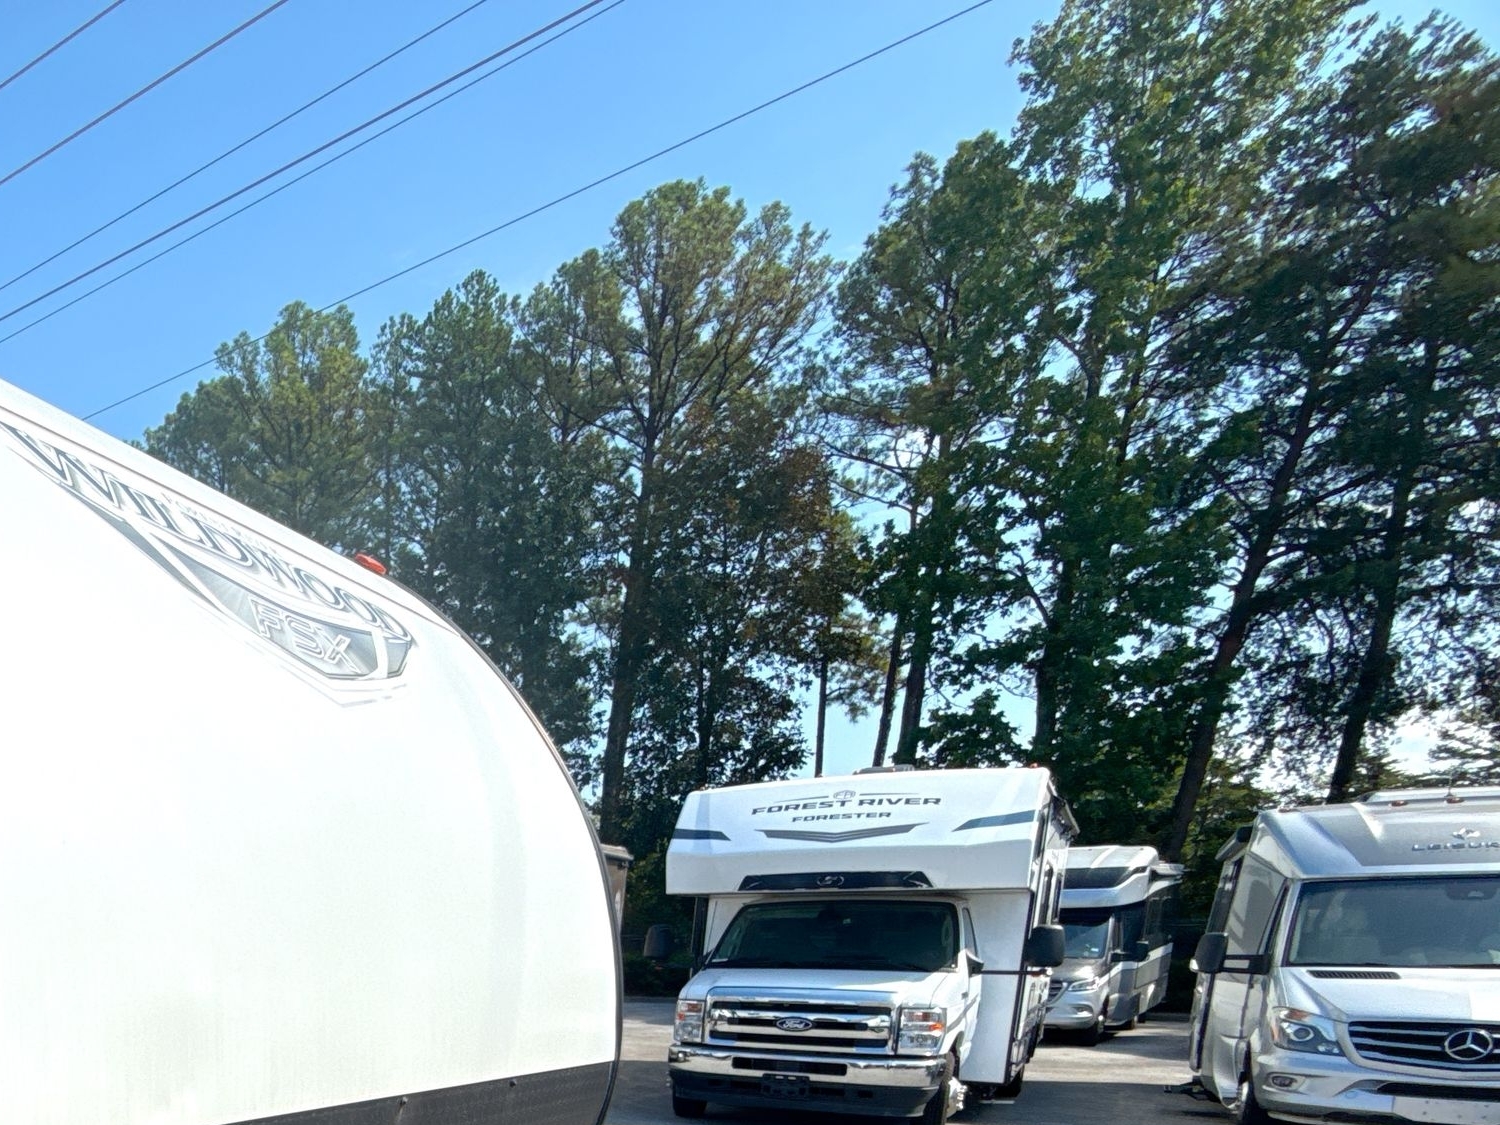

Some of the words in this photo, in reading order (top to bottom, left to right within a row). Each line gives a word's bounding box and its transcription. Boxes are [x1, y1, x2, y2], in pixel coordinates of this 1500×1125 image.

[248, 597, 360, 674] FSX
[751, 800, 853, 816] FOREST
[858, 797, 942, 807] RIVER
[792, 812, 892, 822] FORESTER
[780, 1018, 808, 1030] Ford
